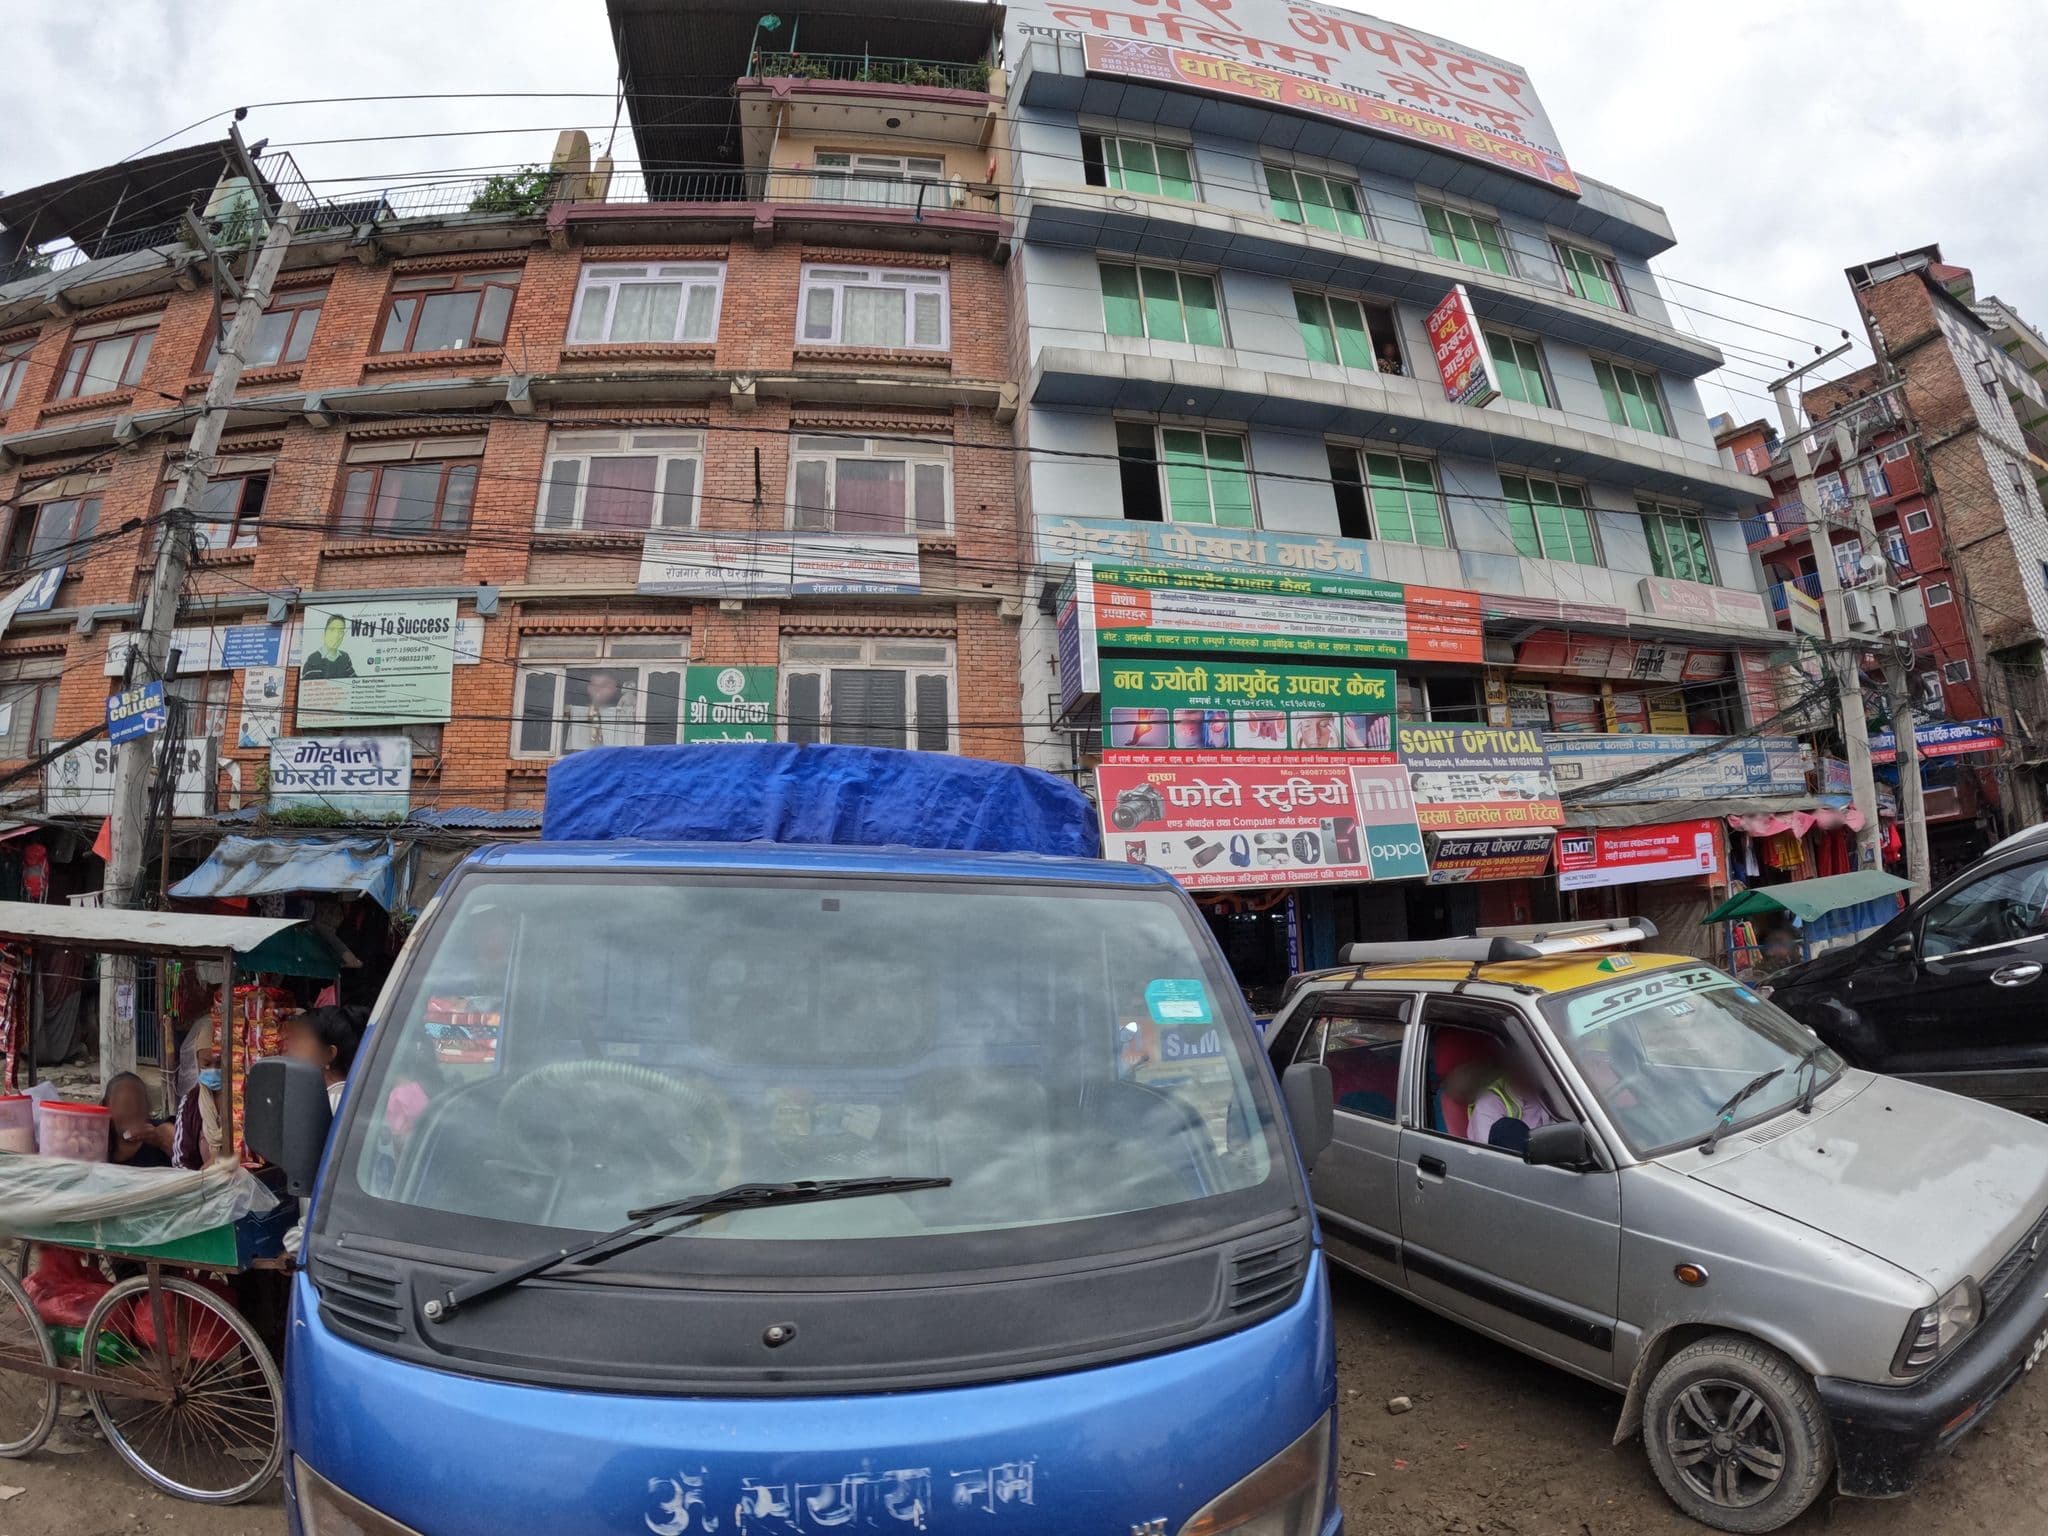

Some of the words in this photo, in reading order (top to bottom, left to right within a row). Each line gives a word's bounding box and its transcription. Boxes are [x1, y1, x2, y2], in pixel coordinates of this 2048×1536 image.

[1465, 130, 1537, 168] होटल
[351, 618, 376, 637] Way
[381, 618, 394, 635] To
[397, 617, 450, 635] Success
[1113, 671, 1144, 689] नव
[1150, 666, 1208, 691] ज्योती
[1213, 669, 1280, 698] आयुर्वेद
[1286, 676, 1341, 696] उपचार
[1346, 673, 1386, 699] केन्द्र
[110, 695, 161, 722] COLLEGE
[690, 695, 708, 723] श्री
[712, 694, 770, 723] कालिका
[1400, 730, 1455, 754] SONY
[1462, 730, 1543, 753] OPTICAL
[1408, 758, 1424, 767] New
[1455, 758, 1493, 768] Kathmandu,
[274, 764, 337, 786] फेन्सी
[341, 765, 402, 786] स्टोर
[1147, 772, 1176, 785] कृष्ण
[1167, 778, 1242, 808] फोटो
[1250, 777, 1349, 812] स्टुडियो
[1233, 816, 1276, 828] Computer
[1418, 808, 1450, 825] चस्मा
[1455, 805, 1501, 825] होलसेल
[1504, 807, 1527, 821] तथा
[1529, 804, 1559, 821] रिटेल
[1371, 842, 1421, 861] oppo
[1440, 841, 1472, 857] होटल
[1491, 838, 1522, 853] पोखरा
[1592, 972, 1712, 1017] SPORTS
[1666, 1001, 1695, 1016] TAXI
